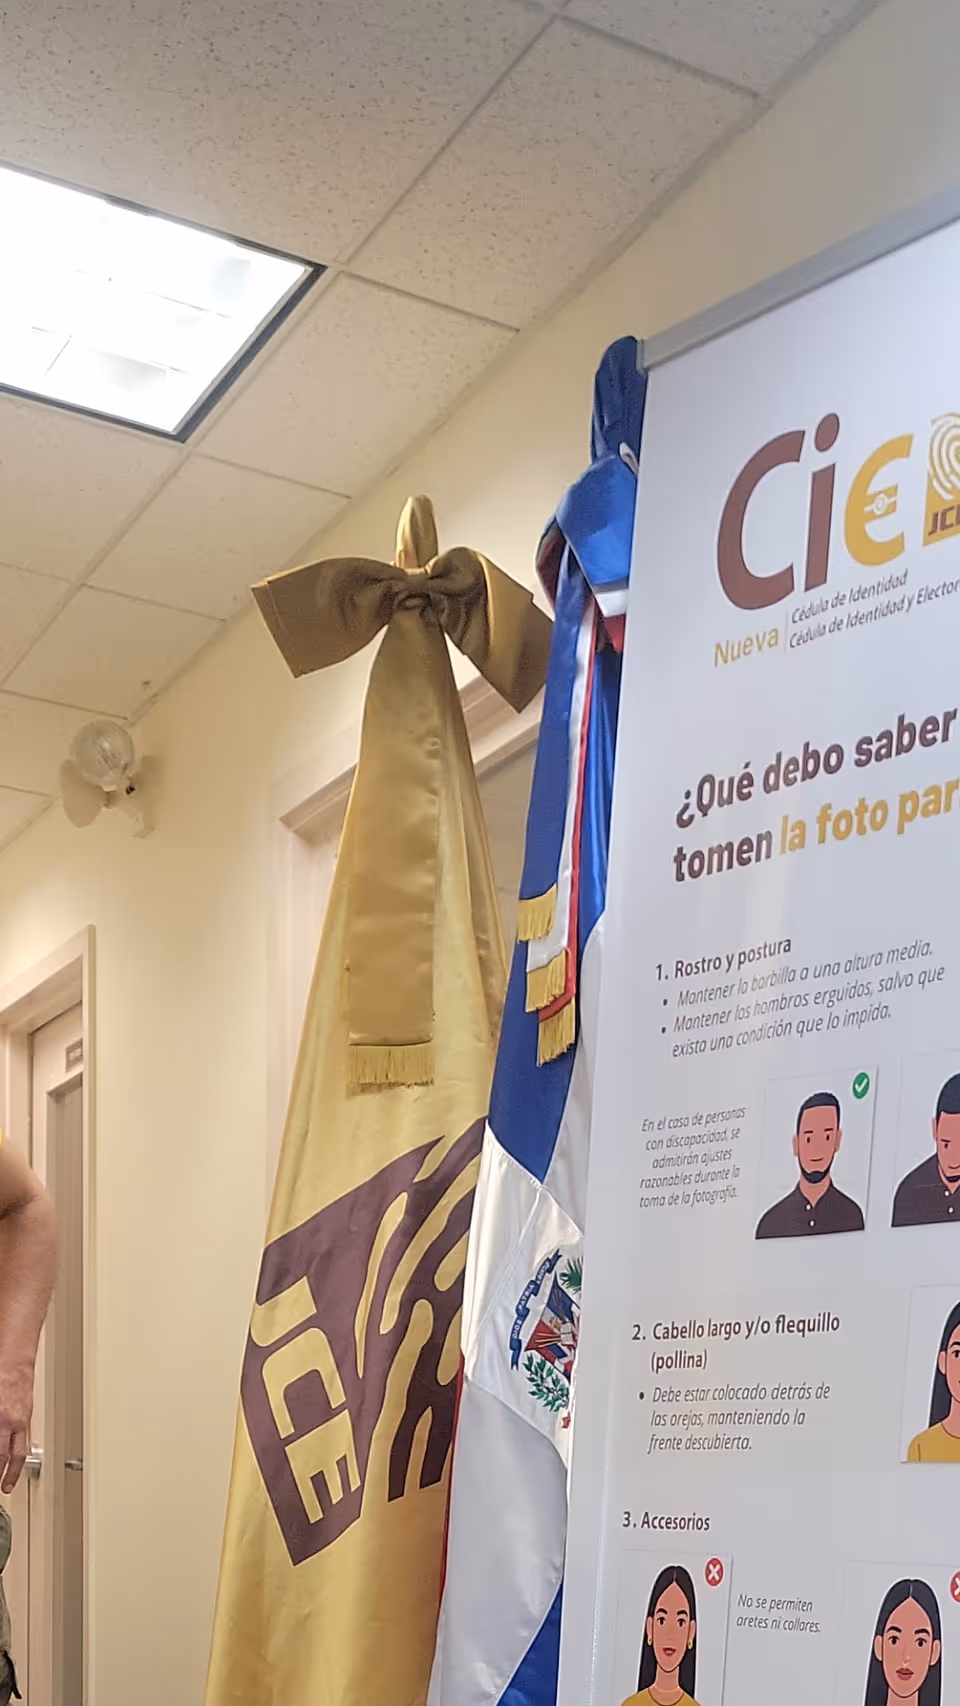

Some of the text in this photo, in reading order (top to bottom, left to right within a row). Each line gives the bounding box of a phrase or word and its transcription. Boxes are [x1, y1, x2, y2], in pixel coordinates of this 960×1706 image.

[791, 568, 909, 625] Cédula de Identidad
[789, 618, 827, 649] Cédula
[828, 616, 844, 633] de
[845, 595, 906, 629] Identidad
[714, 627, 779, 667] Nueva
[675, 759, 754, 829] ¿Qué
[763, 738, 844, 794] debo
[854, 711, 957, 768] saber
[673, 826, 774, 882] tomen
[780, 812, 806, 855] la
[817, 796, 889, 845] foto
[655, 938, 792, 981] 1. Rostro y postura
[677, 939, 933, 1008] Mantener barbilla una altura media.
[673, 966, 945, 1033] Mantener los hombros erguidos, salvo que
[672, 1001, 892, 1058] exista una condición que lo impida.
[705, 1107, 746, 1128] personas
[701, 1148, 733, 1167] ajustes
[640, 1167, 731, 1189] razonables durante
[640, 1195, 665, 1208] toma
[631, 1311, 841, 1341] 2. Cabello largo y/o flequillo
[650, 1349, 708, 1374] (pollina)
[652, 1381, 831, 1404] Debe estar colocado detrás de
[650, 1408, 806, 1431] las orejas, manteniendo la
[647, 1433, 753, 1455] frente descubierta.
[622, 1511, 711, 1531] 3. Accesorios
[737, 1593, 813, 1614] No se permiten
[736, 1616, 821, 1633] aretes collares.
